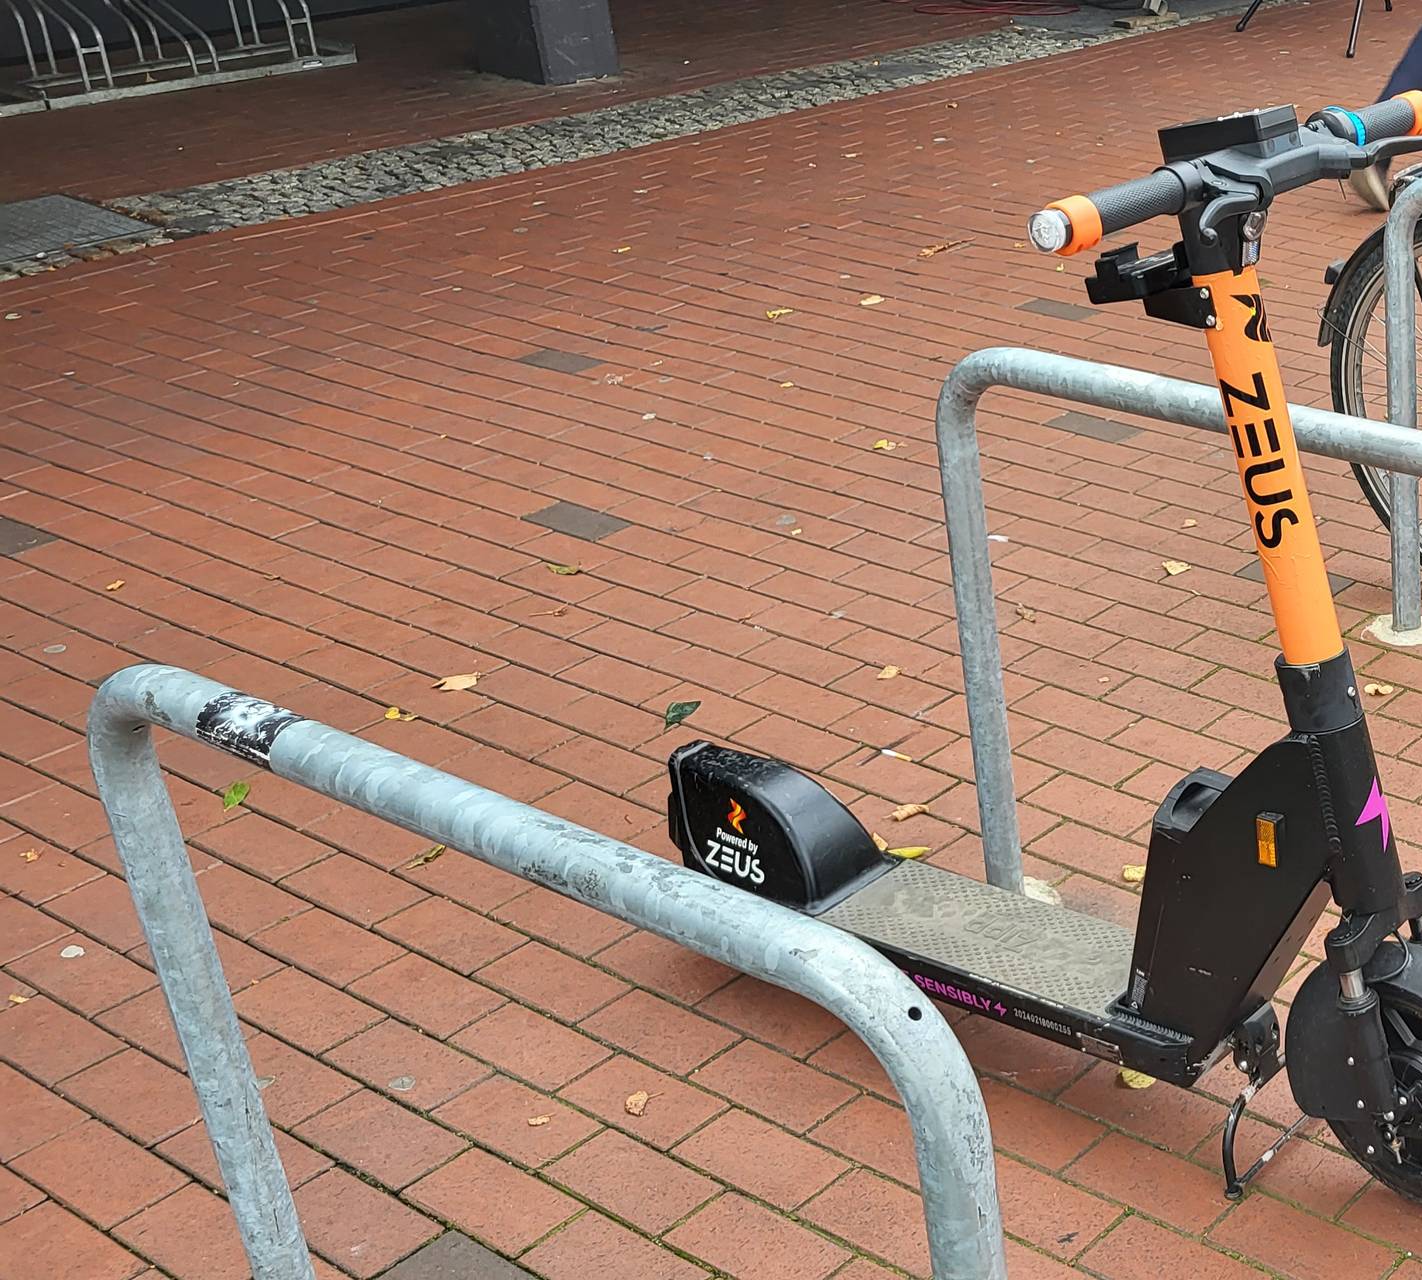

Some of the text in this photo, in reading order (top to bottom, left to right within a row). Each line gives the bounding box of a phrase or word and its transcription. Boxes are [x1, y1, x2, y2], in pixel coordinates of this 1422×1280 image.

[1219, 371, 1300, 549] ZEUS
[705, 839, 765, 884] ZEUS
[716, 827, 759, 855] Powered by
[914, 974, 992, 1011] SENSIBLY
